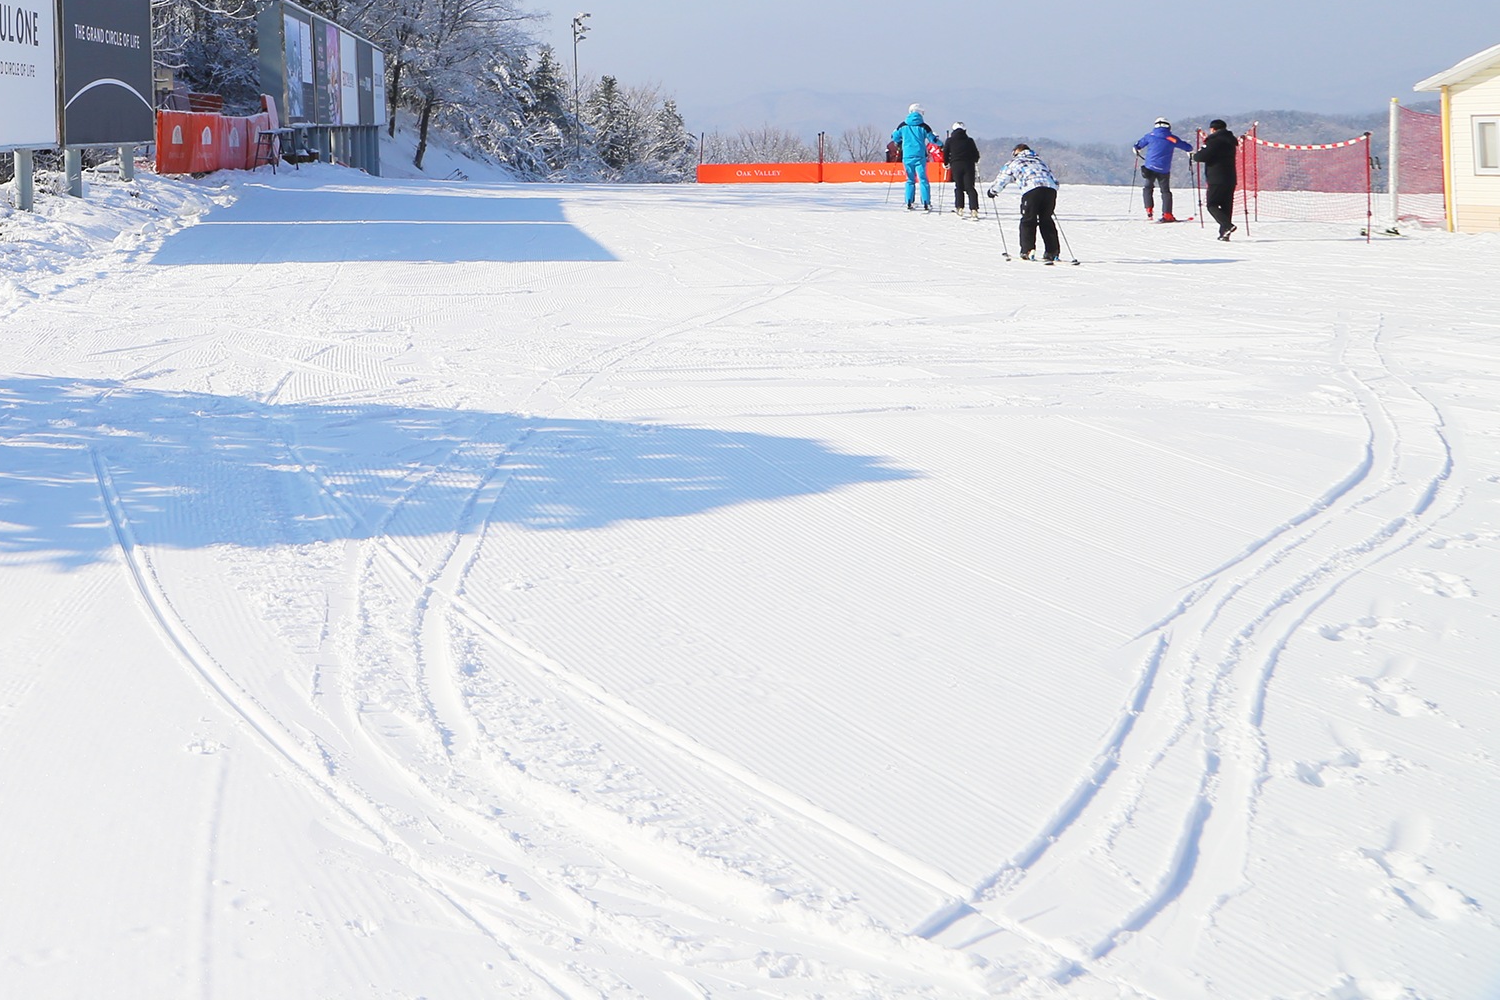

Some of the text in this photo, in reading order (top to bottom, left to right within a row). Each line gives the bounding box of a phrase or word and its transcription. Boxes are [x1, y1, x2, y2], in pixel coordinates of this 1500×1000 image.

[74, 23, 140, 49] THE GRAND CIRCLE OF LIFE
[5, 61, 20, 76] CIRCLE
[27, 64, 35, 78] LIFE
